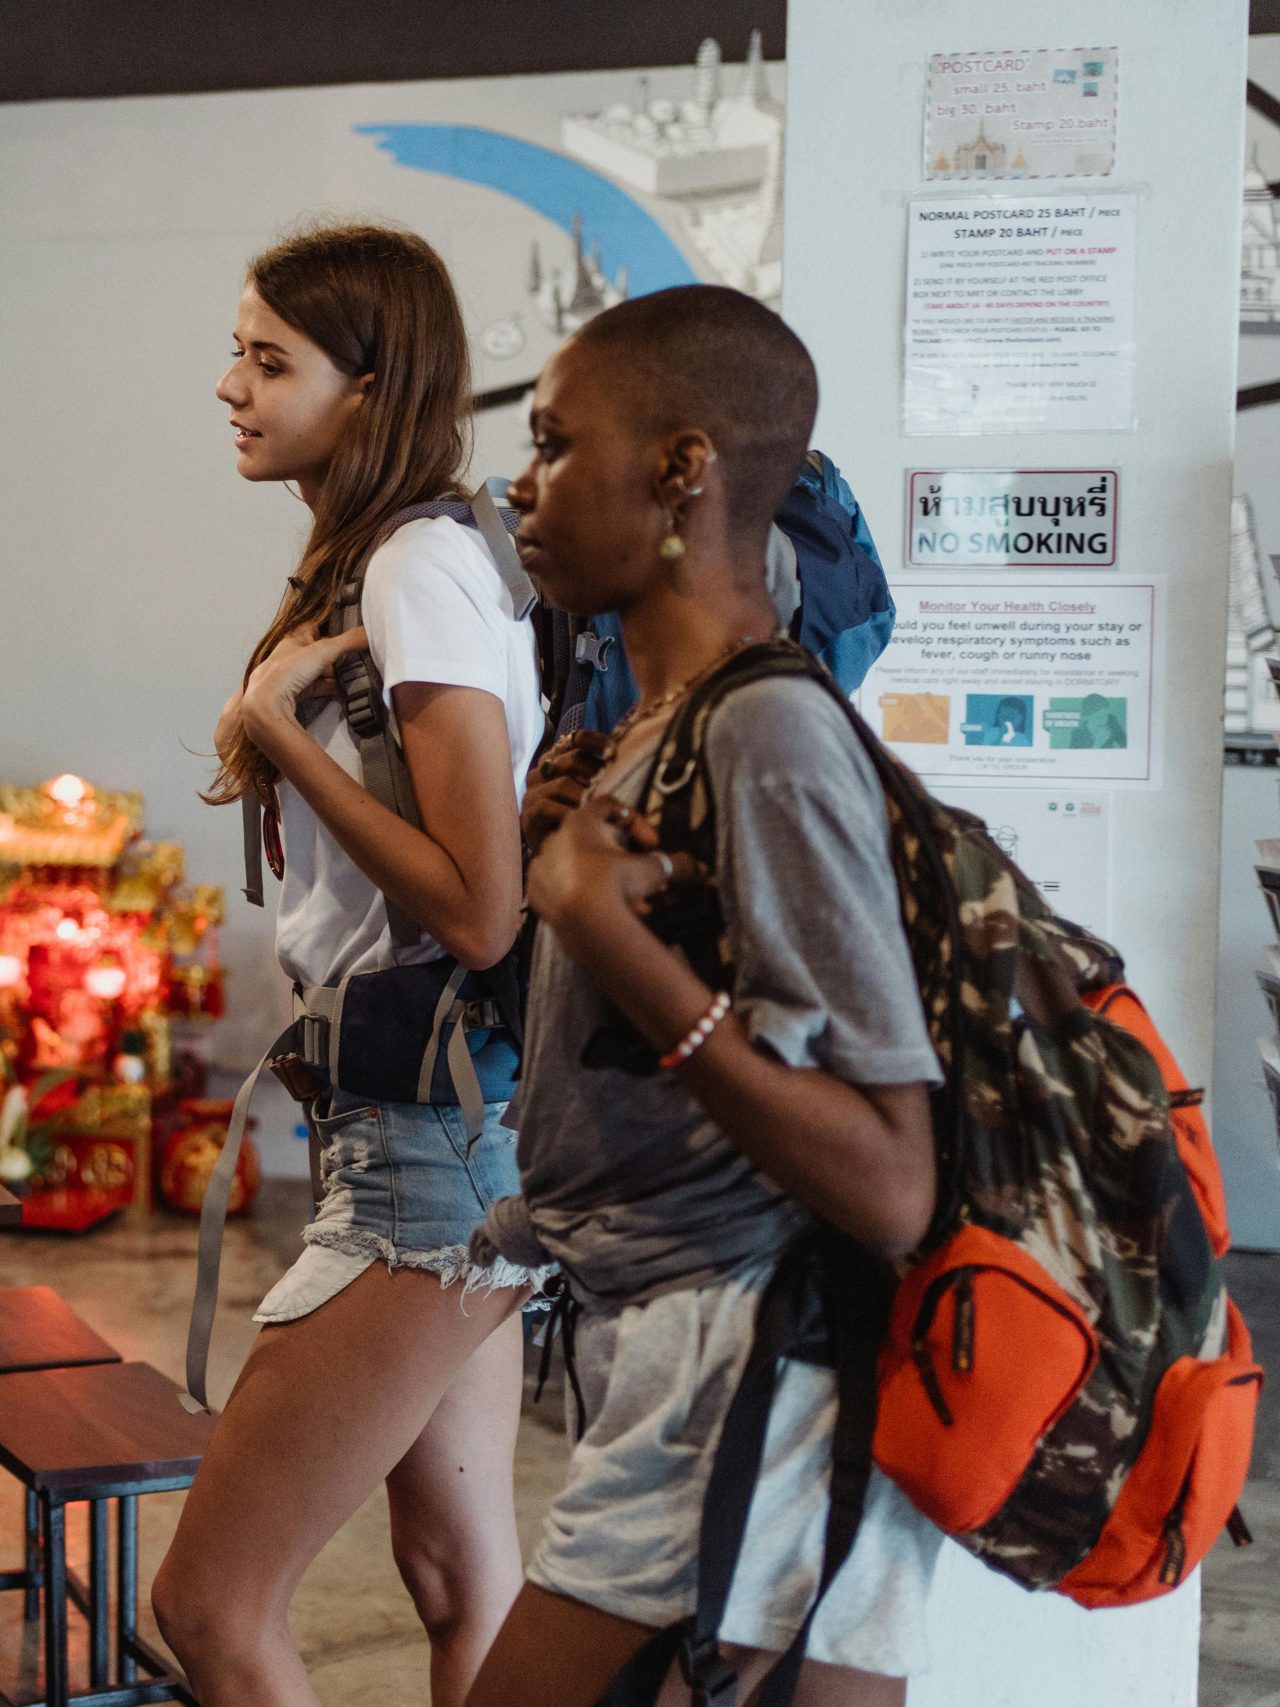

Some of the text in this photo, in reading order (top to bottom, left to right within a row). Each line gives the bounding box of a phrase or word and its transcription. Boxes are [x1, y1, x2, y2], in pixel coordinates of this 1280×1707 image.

[953, 83, 988, 95] small
[1015, 82, 1046, 92] baht
[936, 105, 956, 118] big
[984, 103, 1016, 113] baht
[1013, 120, 1054, 132] Stamp
[919, 211, 969, 221] NORMAL
[973, 209, 1034, 219] POSTCARD
[1037, 208, 1051, 218] 25
[1054, 207, 1086, 218] BAHT
[954, 228, 996, 239] STAMP
[999, 228, 1013, 238] 20
[1016, 227, 1048, 237] BAHT
[919, 476, 1108, 527] ห้ามสูบบุหรี่
[918, 532, 1108, 554] NO SMOKING
[919, 601, 1096, 614] Monitor Your Health Closely
[921, 622, 945, 632] you
[948, 620, 972, 631] feel
[975, 620, 1016, 631] unwell
[1020, 621, 1061, 634] during
[1064, 623, 1095, 634] your
[1098, 622, 1125, 633] stay
[1128, 623, 1143, 632] or
[937, 635, 1005, 648] respiratory
[1009, 637, 1076, 648] symptoms
[1080, 636, 1112, 646] such
[1115, 638, 1131, 646] as
[960, 650, 999, 662] cough
[1002, 651, 1017, 660] or
[1020, 652, 1056, 663] runny
[1060, 652, 1092, 661] nose
